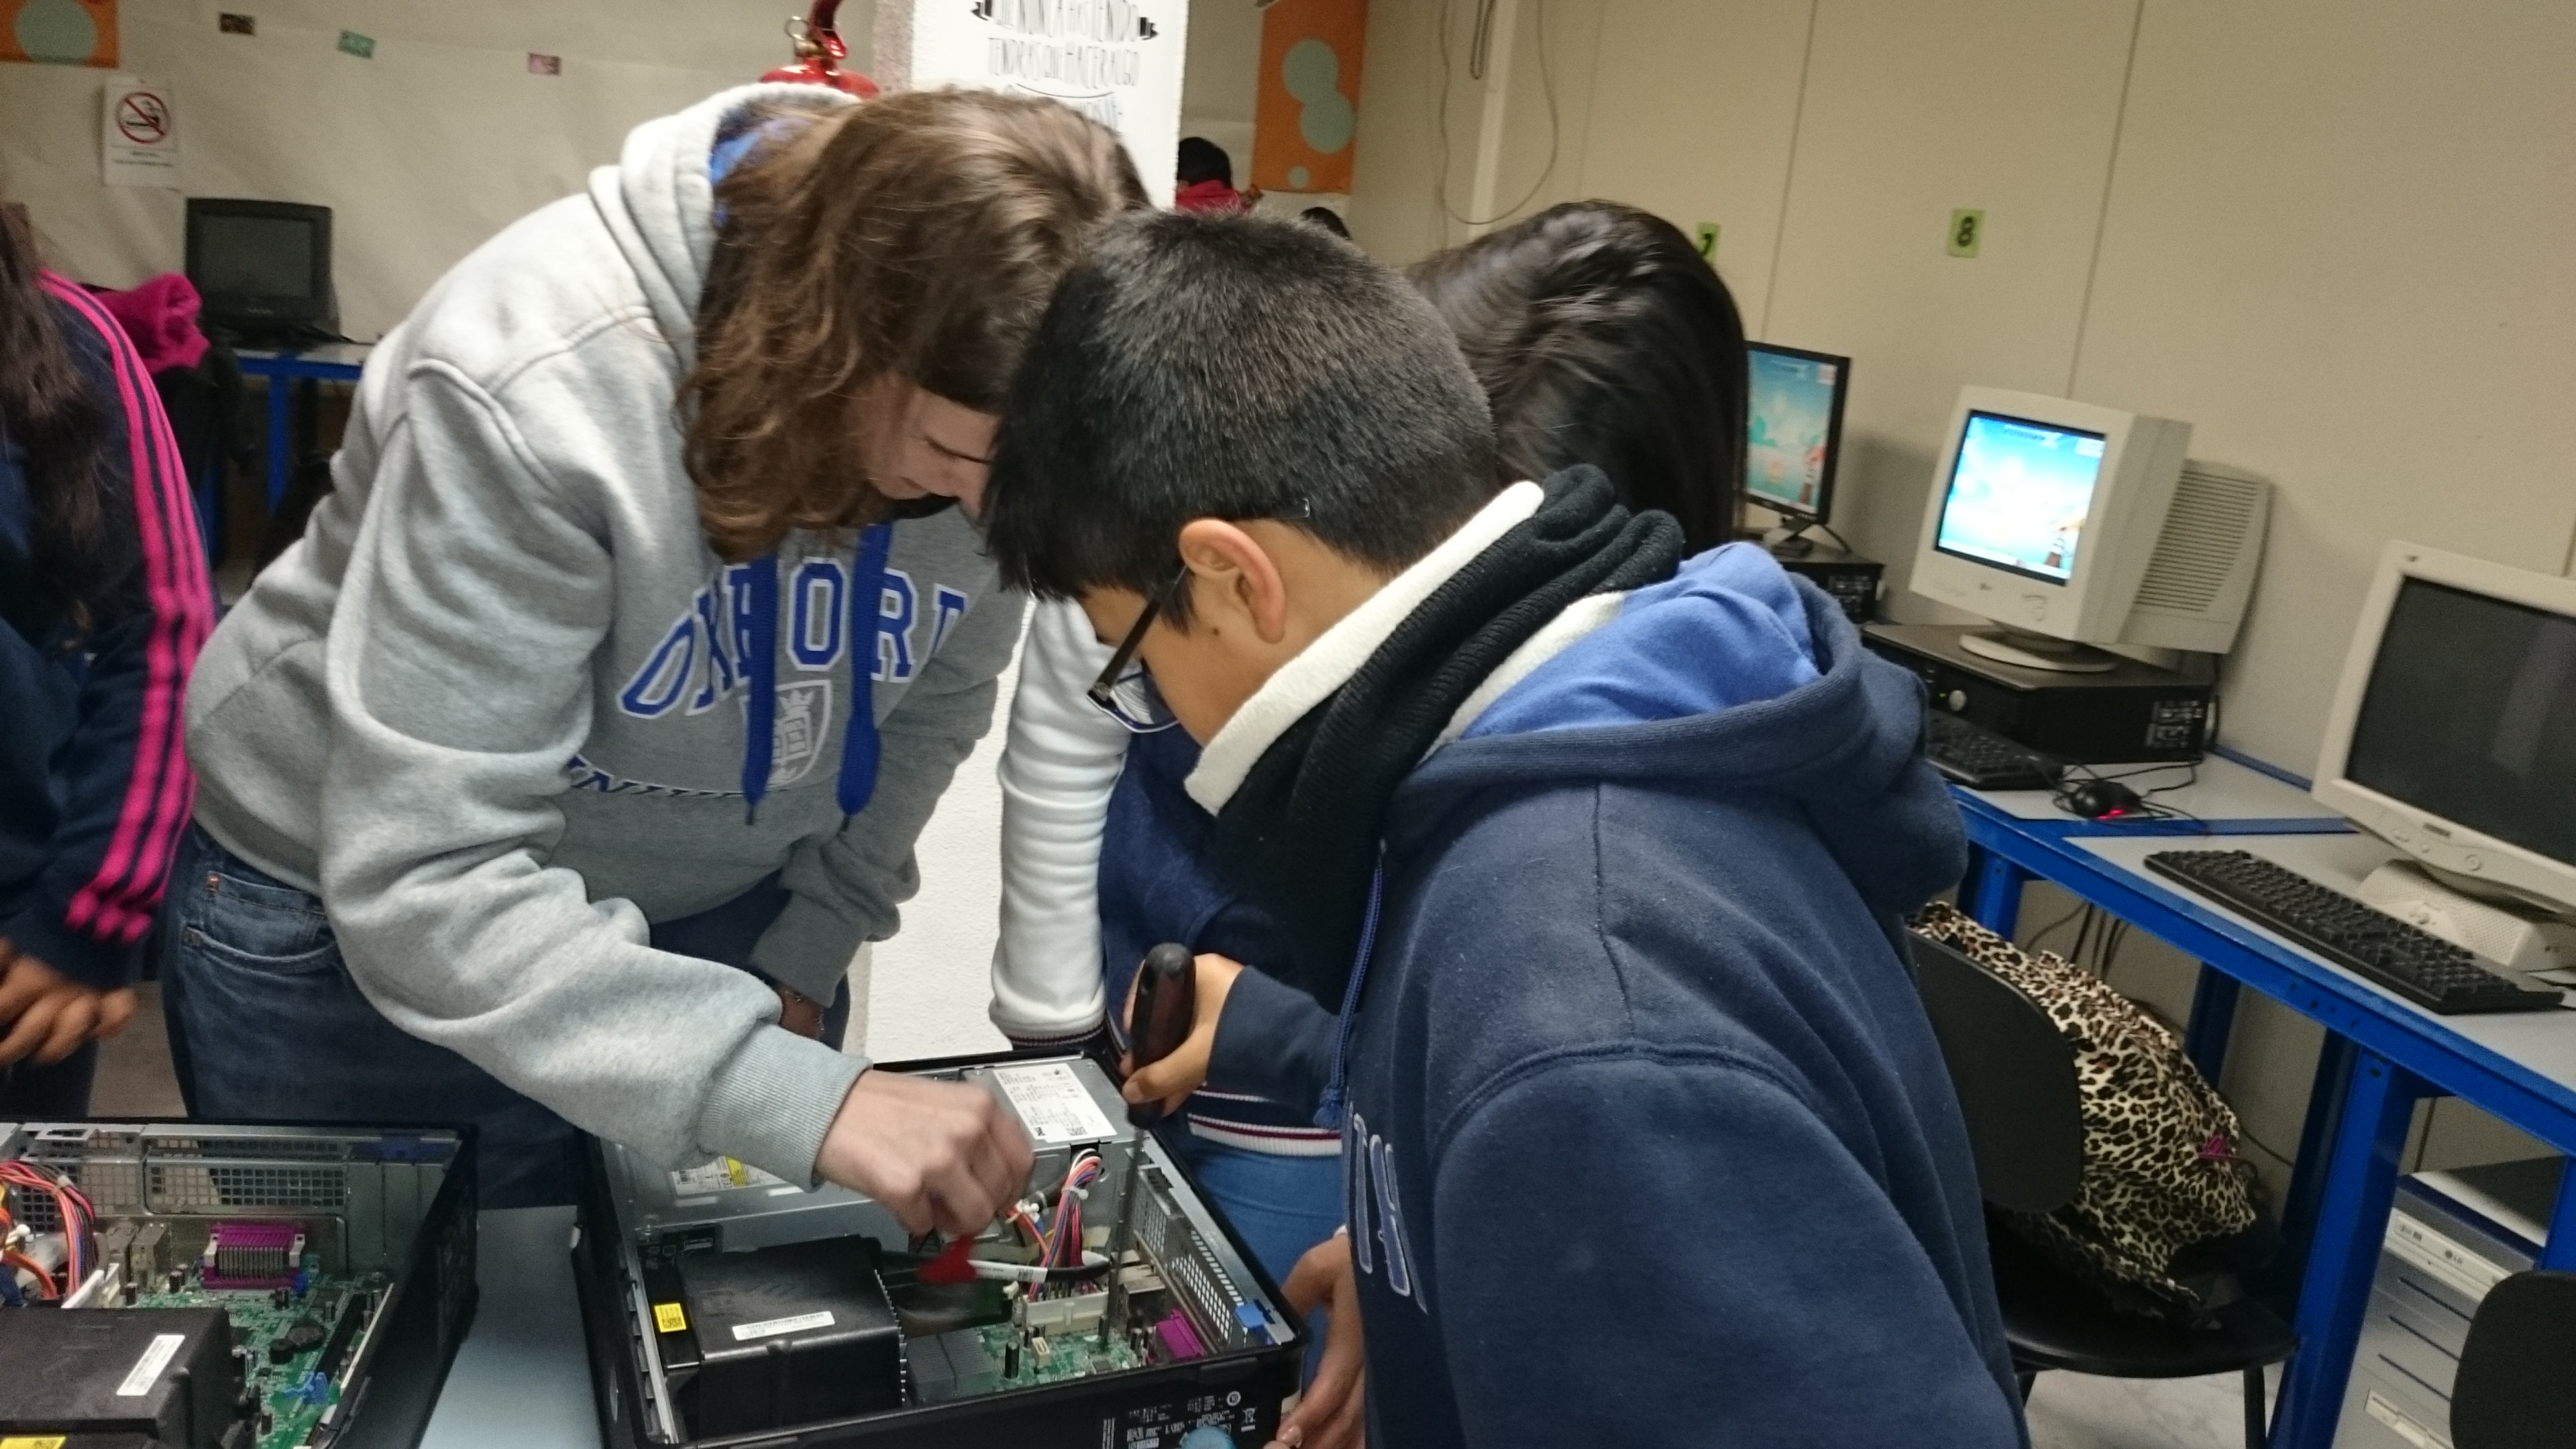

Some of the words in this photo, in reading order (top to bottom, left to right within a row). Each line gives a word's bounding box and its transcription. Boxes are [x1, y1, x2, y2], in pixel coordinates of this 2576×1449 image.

[1064, 41, 1108, 90] HACER
[1109, 46, 1140, 87] ALGO
[1956, 215, 1974, 248] 8
